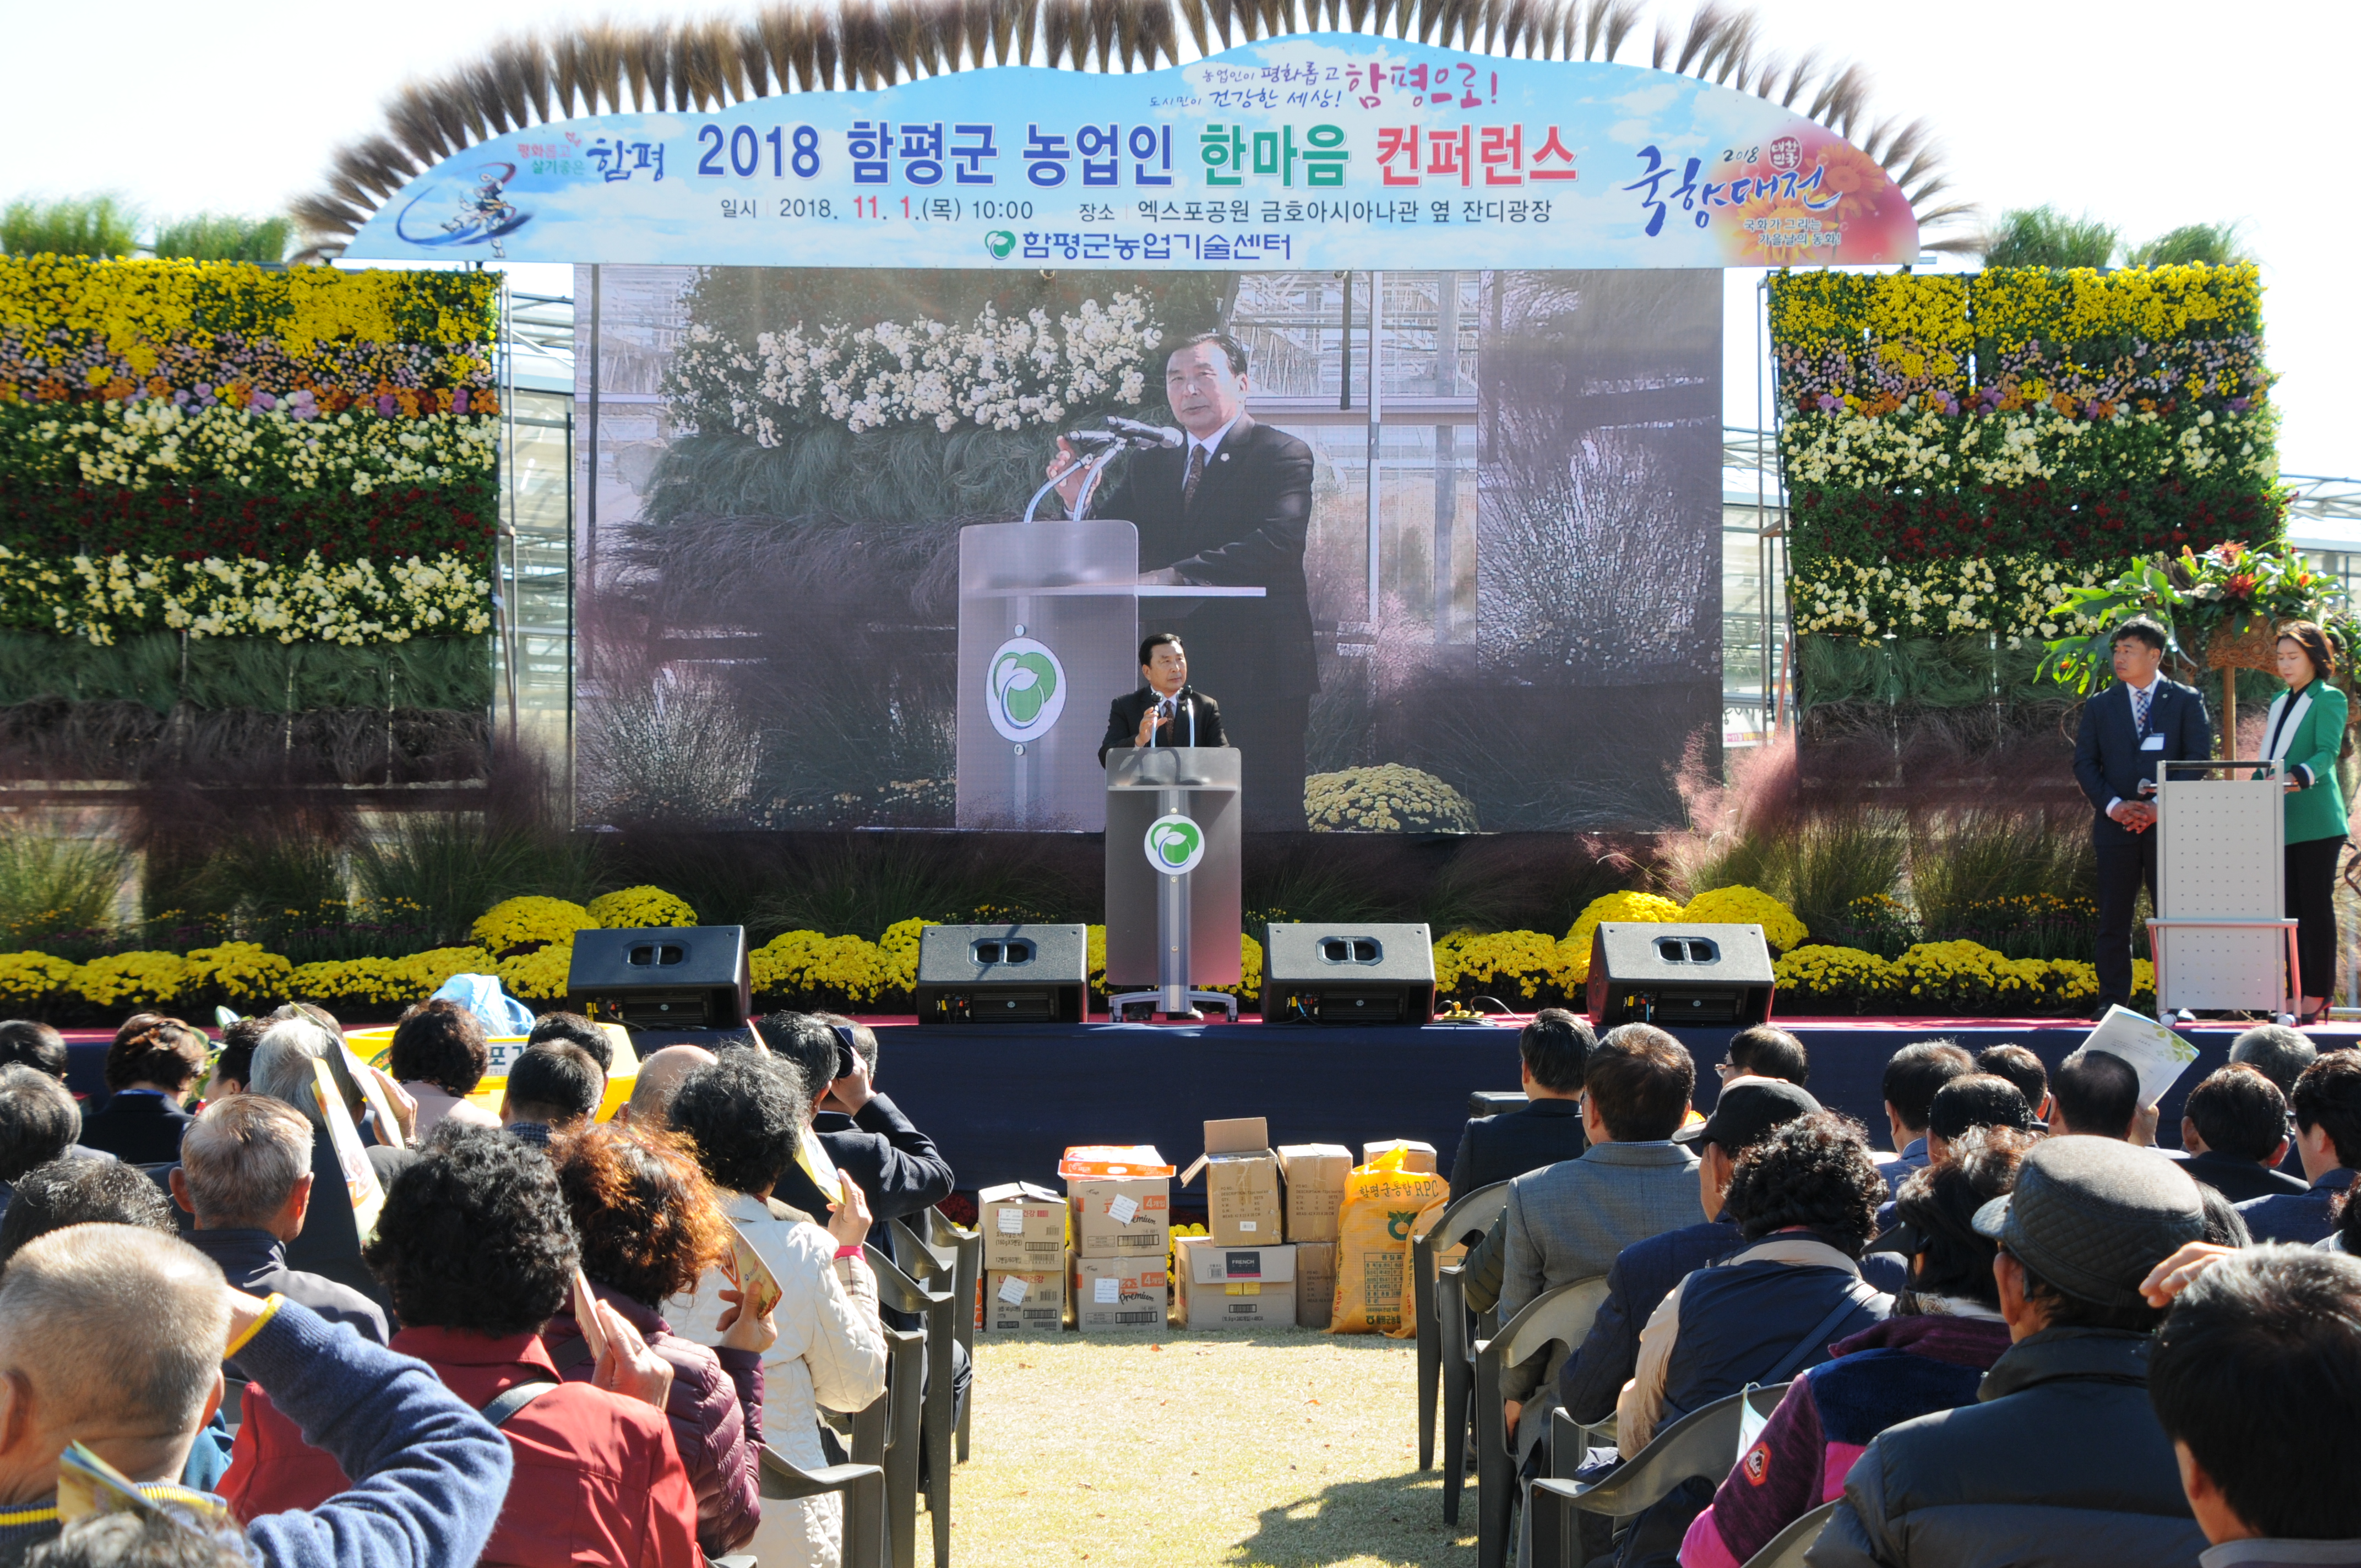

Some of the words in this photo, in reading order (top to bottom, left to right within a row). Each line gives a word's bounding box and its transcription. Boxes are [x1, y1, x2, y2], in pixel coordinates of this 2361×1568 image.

[1202, 68, 1255, 84] 농업인이
[1260, 61, 1340, 86] 평화롭고
[1345, 62, 1498, 109] 함평으로!
[1150, 96, 1201, 107] 도시민이
[1209, 88, 1279, 109] 건강한
[1286, 89, 1342, 107] 세상!
[586, 138, 665, 183] 함평
[696, 122, 822, 178] 2018
[846, 119, 1000, 186] 함평군
[1022, 121, 1174, 188] 농업인
[1200, 123, 1351, 188] 한마음
[1375, 123, 1579, 188] 컨퍼런스
[1723, 145, 1760, 164] 2018
[531, 159, 584, 175] 살기좋은
[1622, 144, 1842, 237] 국향대전
[720, 199, 757, 219] 일시
[779, 198, 839, 220] 2018.
[972, 200, 1033, 220] 10:00
[1079, 201, 1116, 223] 장소
[1138, 199, 1250, 224] 엑스포공원
[1260, 199, 1419, 224] 금호아시아나관
[1430, 199, 1451, 223] 옆
[1462, 199, 1553, 224] 잔디광장
[1744, 219, 1781, 232] 국화가
[1785, 219, 1821, 231] 그리는
[1022, 231, 1291, 260] 함평군농업기술센터
[1759, 233, 1808, 246] 가을날의
[1812, 233, 1841, 246] 동화!
[1358, 1180, 1412, 1199] 함평군통합
[1414, 1179, 1439, 1197] RPC
[1145, 1197, 1166, 1208] 4개입
[1122, 1215, 1156, 1228] emium
[1144, 1275, 1164, 1285] 4개입
